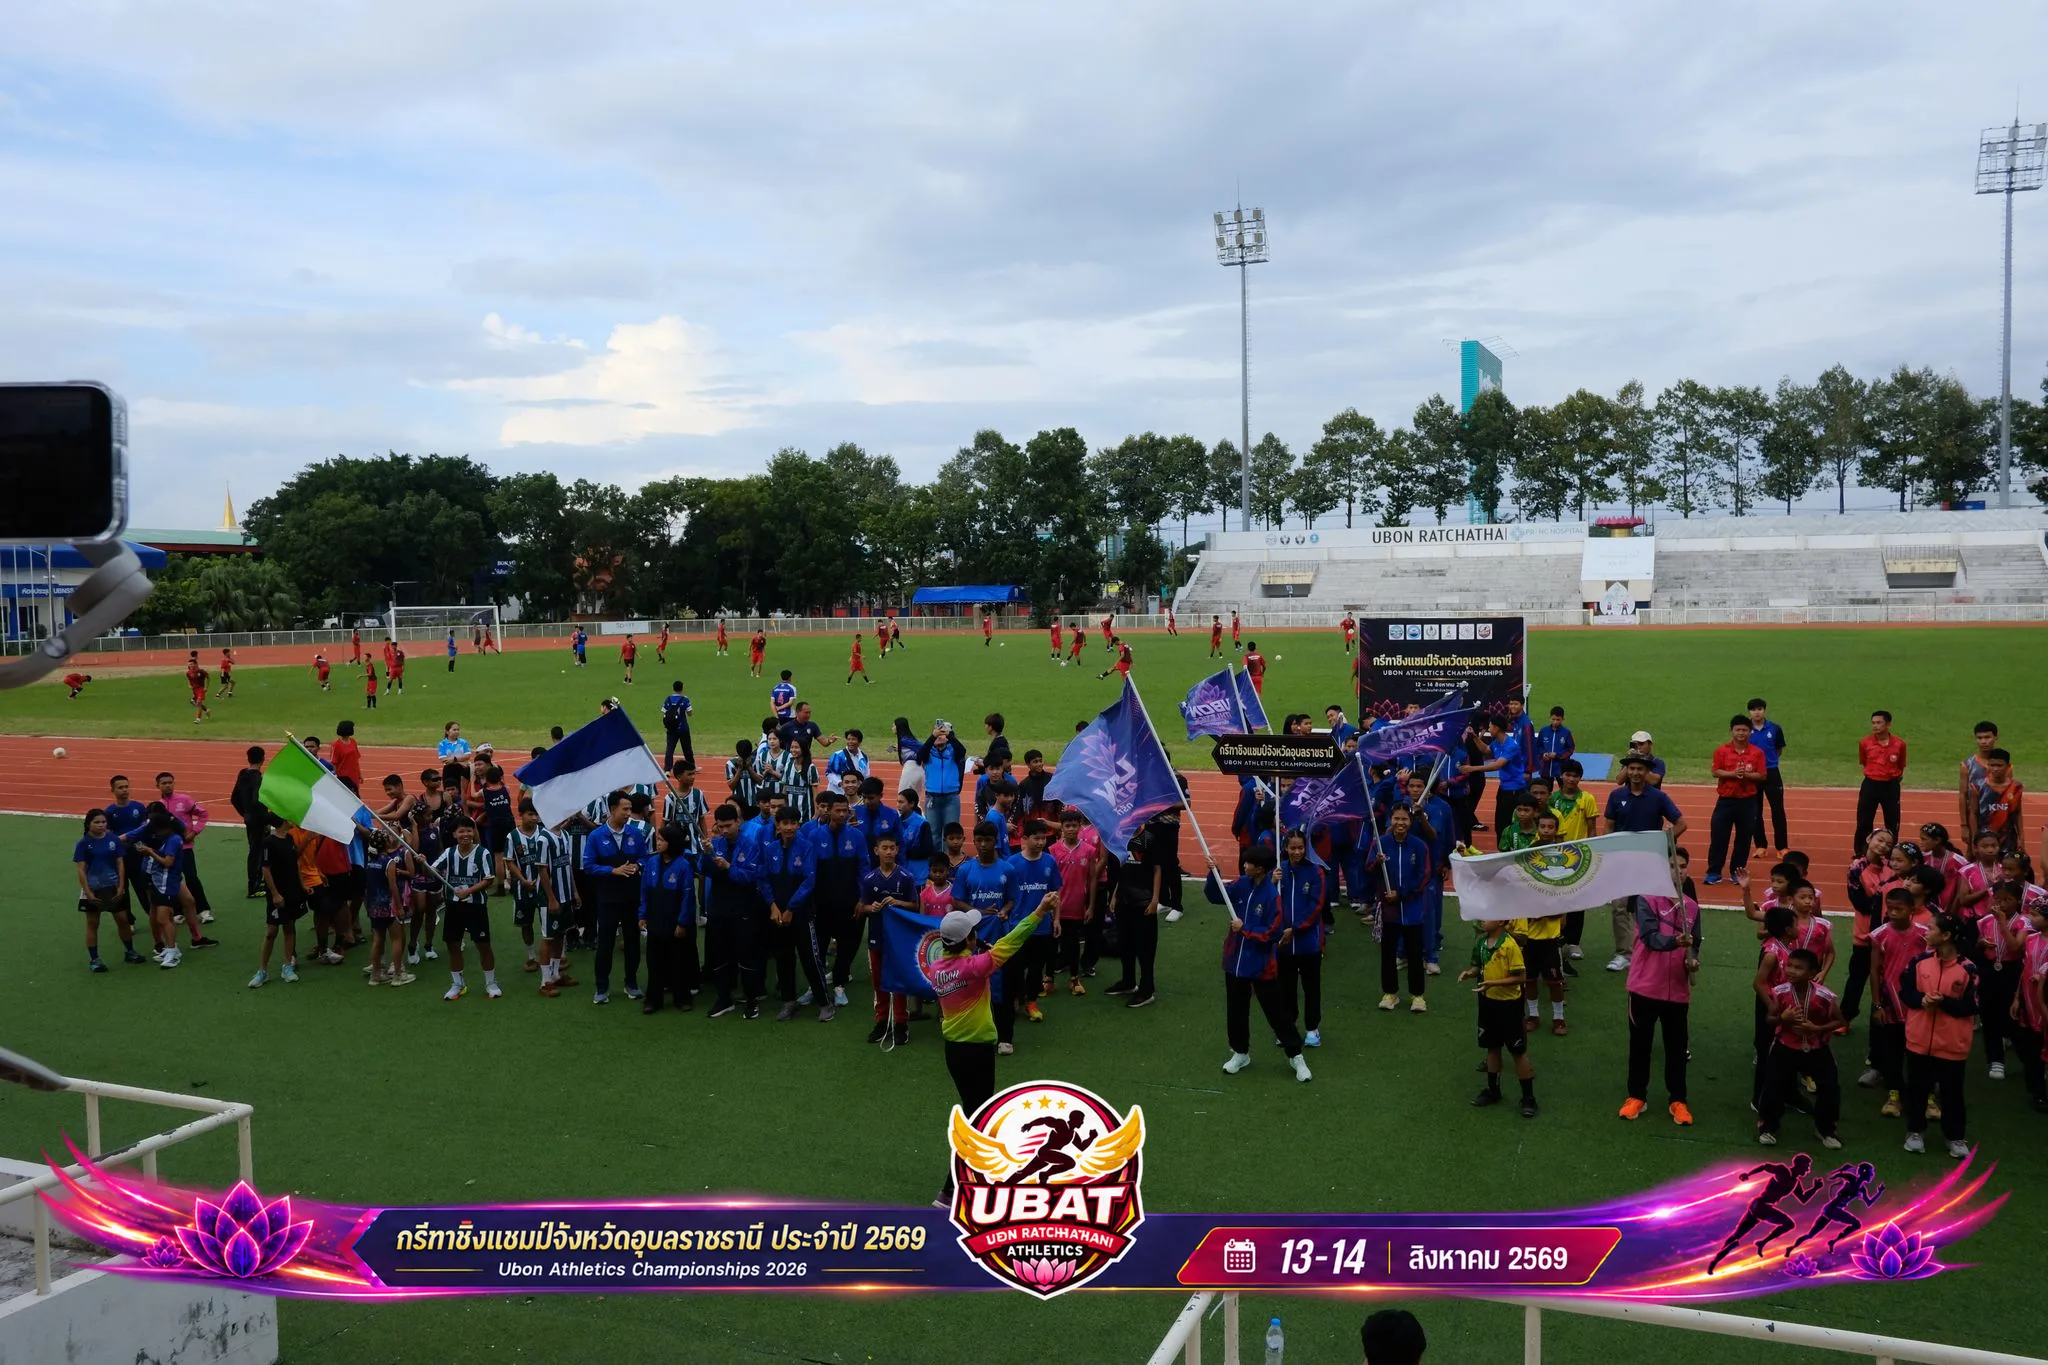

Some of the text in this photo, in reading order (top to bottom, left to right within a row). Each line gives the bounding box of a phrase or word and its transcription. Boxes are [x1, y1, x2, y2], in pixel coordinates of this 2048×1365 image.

[1550, 527, 1585, 535] HOSPITAL
[1372, 530, 1413, 544] UBON
[1280, 761, 1331, 769] CHAMPIONSHIPS
